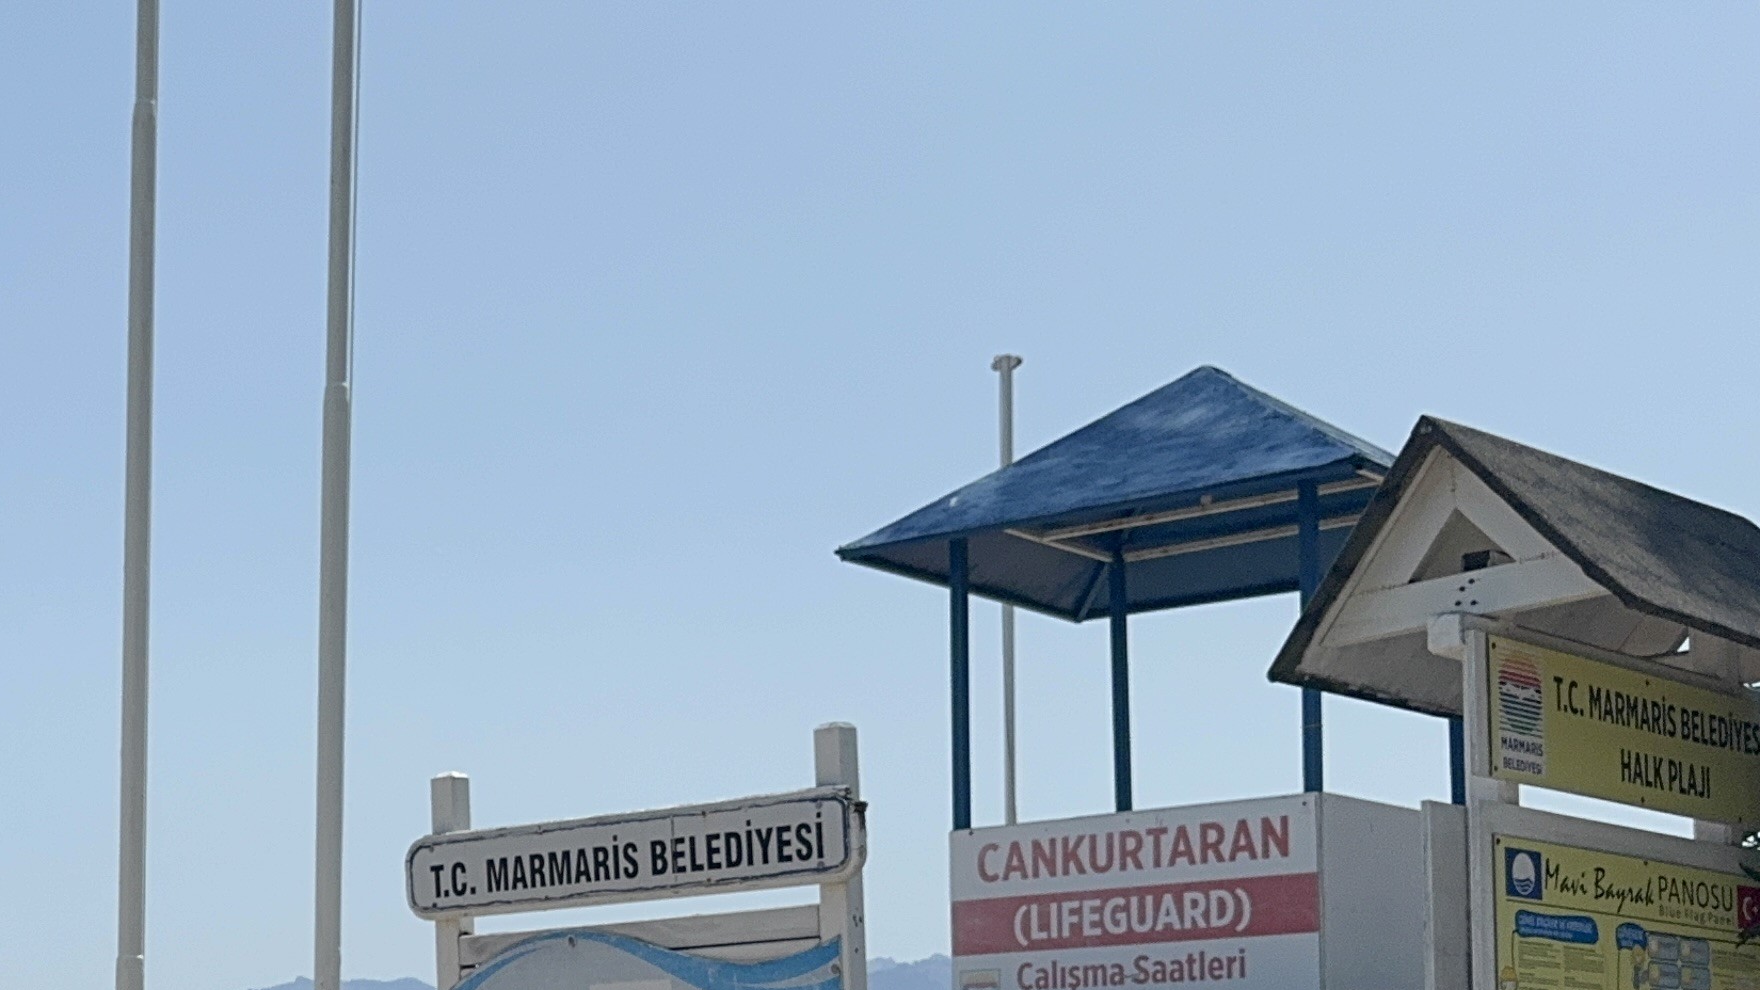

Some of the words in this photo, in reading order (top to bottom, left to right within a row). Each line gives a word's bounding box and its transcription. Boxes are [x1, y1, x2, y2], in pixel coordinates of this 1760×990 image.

[1553, 676, 1584, 717] T.C.
[1589, 685, 1676, 738] MARMARİS
[1620, 749, 1664, 790] HALK
[1669, 759, 1711, 799] PLAJI
[431, 864, 476, 898] T.C.
[486, 834, 639, 893] MARMARİS
[650, 812, 824, 875] BELEDİYESİ
[977, 815, 1290, 883] CANKURTARAN
[1545, 858, 1588, 894] Mavi
[1594, 867, 1654, 914] Bayrak
[1658, 875, 1733, 912] PANOSU
[1014, 888, 1252, 947] (LIFEGUARD)
[1132, 948, 1246, 985] Saatleri
